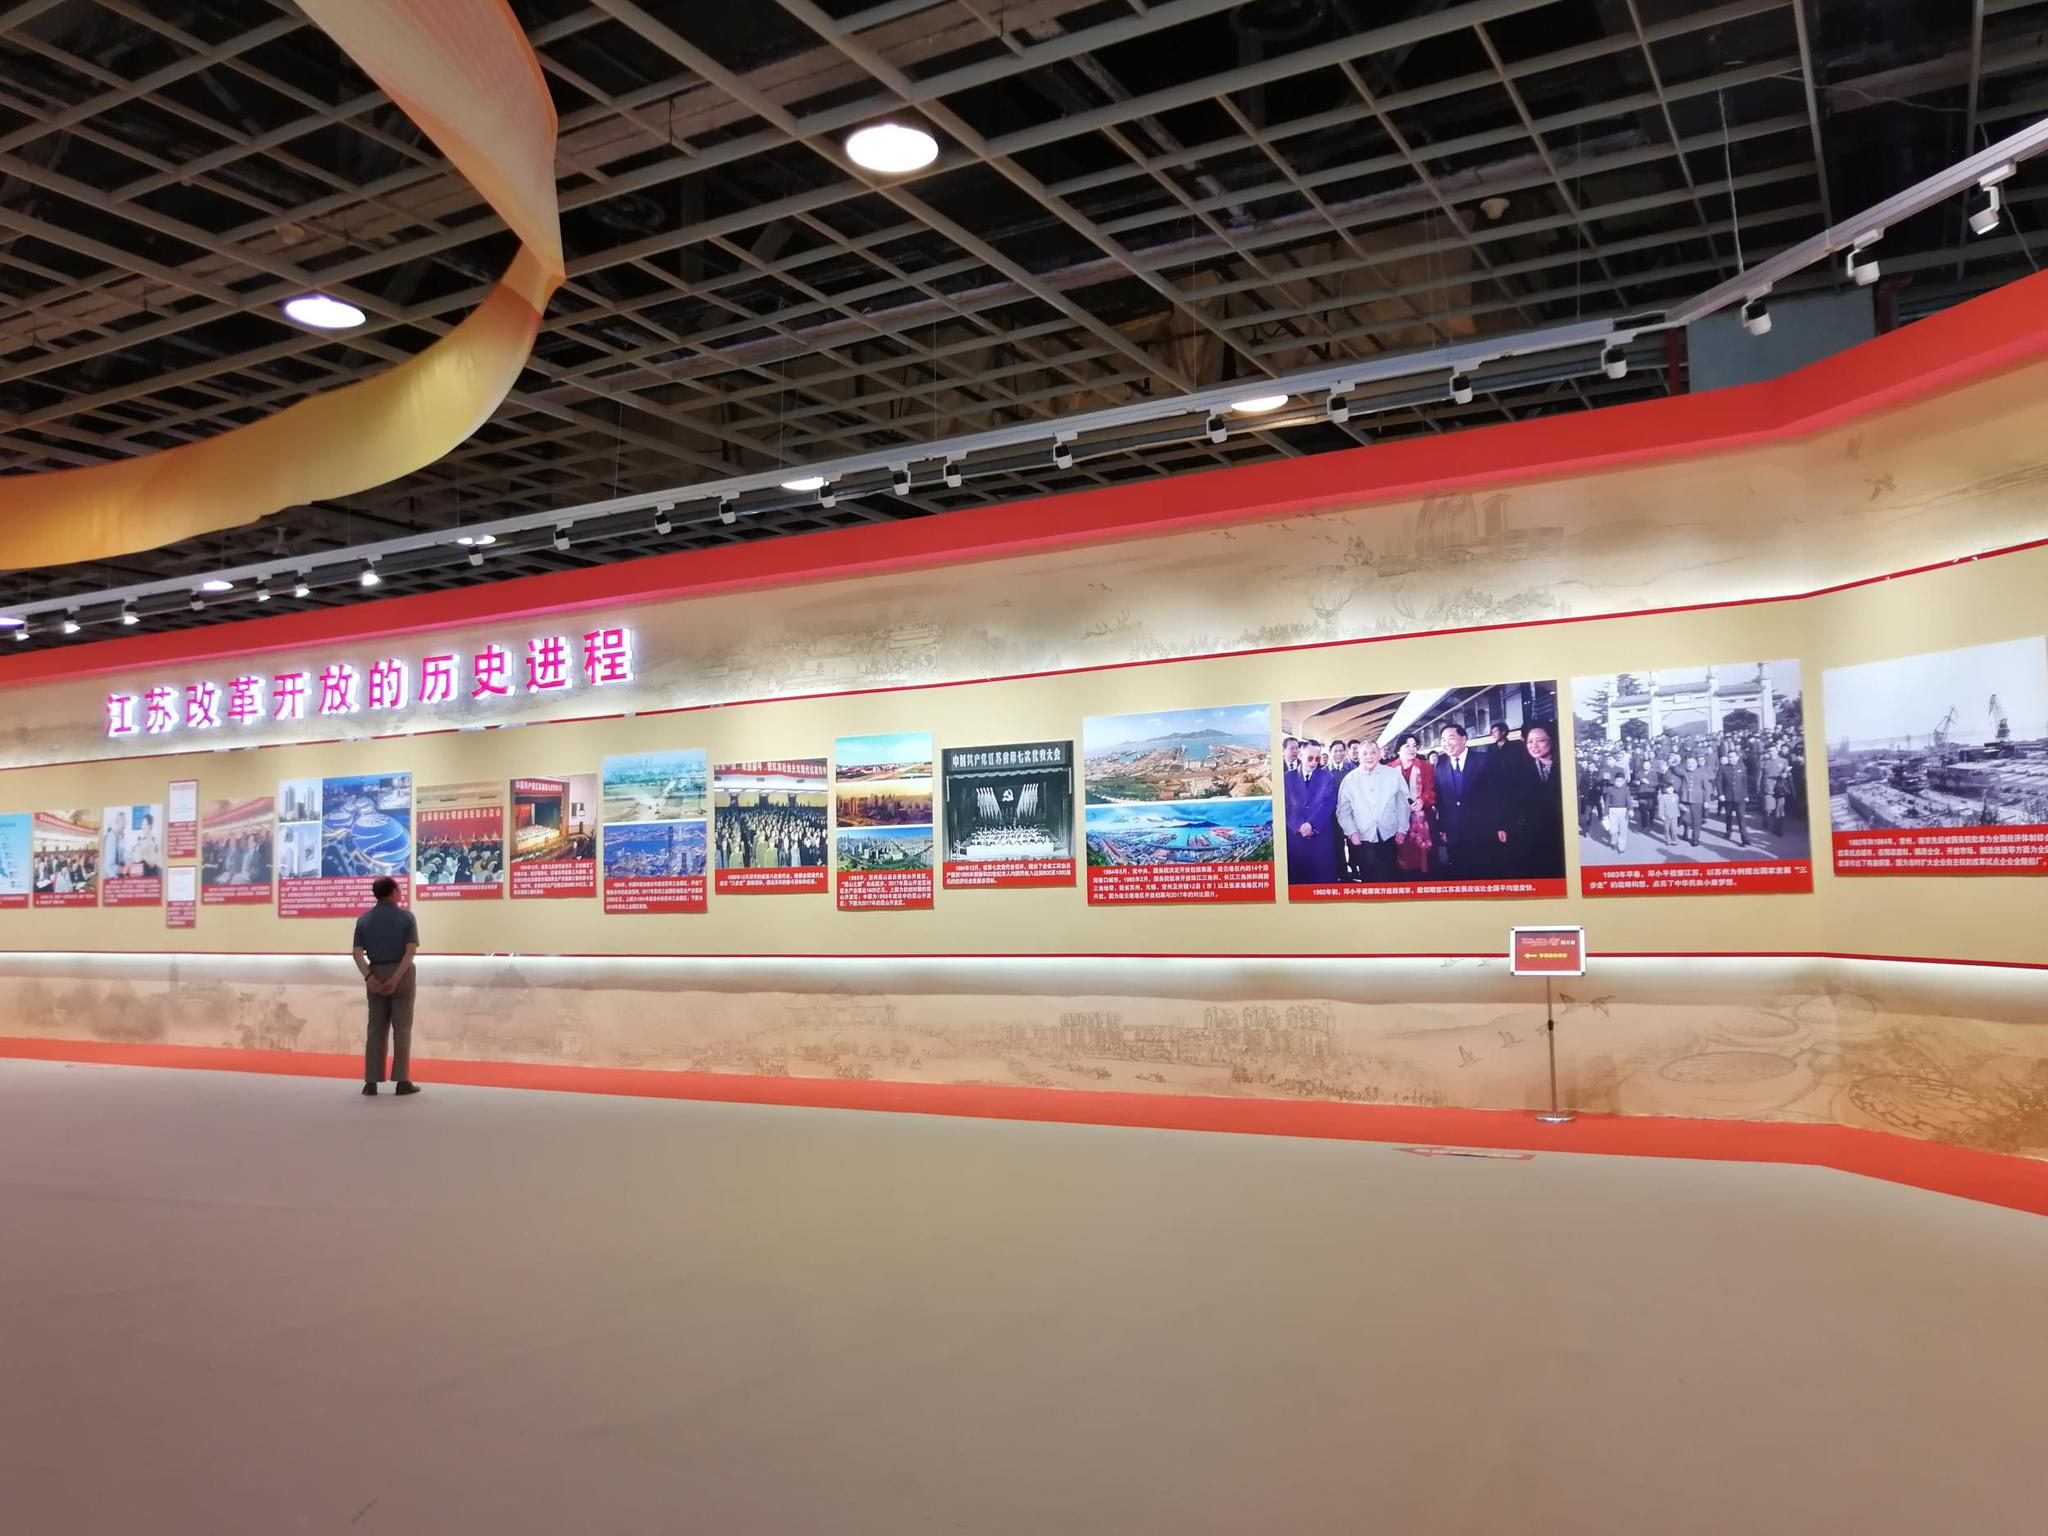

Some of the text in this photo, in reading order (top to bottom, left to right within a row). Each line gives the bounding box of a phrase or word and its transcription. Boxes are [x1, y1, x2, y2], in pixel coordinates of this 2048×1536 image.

[106, 626, 635, 740] 江苏改革开放的历史进程
[952, 747, 1061, 768] 中国共产党江苏省第七次代表大会
